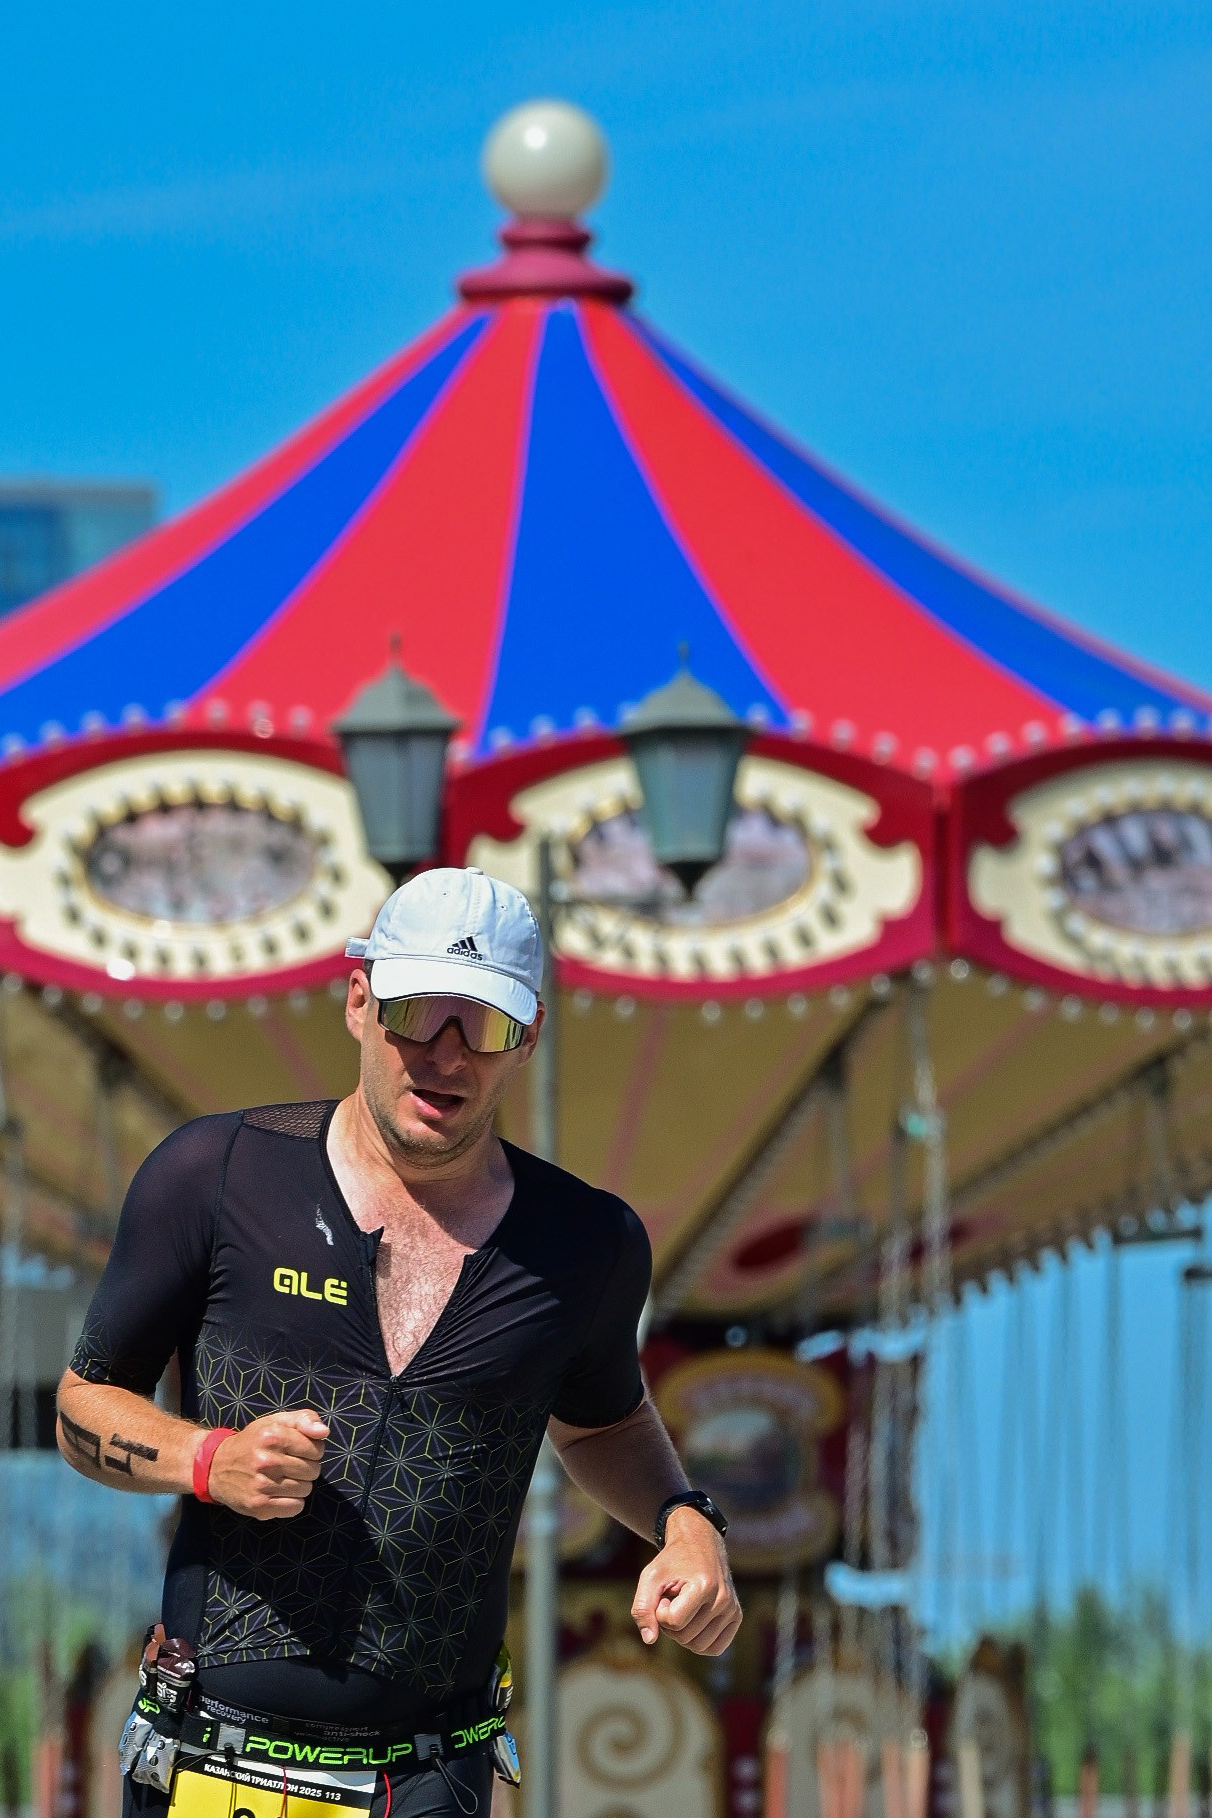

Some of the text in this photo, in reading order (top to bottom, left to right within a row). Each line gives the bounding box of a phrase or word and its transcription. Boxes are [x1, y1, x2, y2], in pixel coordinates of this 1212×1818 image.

[446, 946, 483, 961] adidas
[206, 1705, 247, 1725] recovery
[245, 1736, 413, 1765] POWERUP
[298, 1786, 323, 1798] 2025
[325, 1791, 342, 1801] 113
